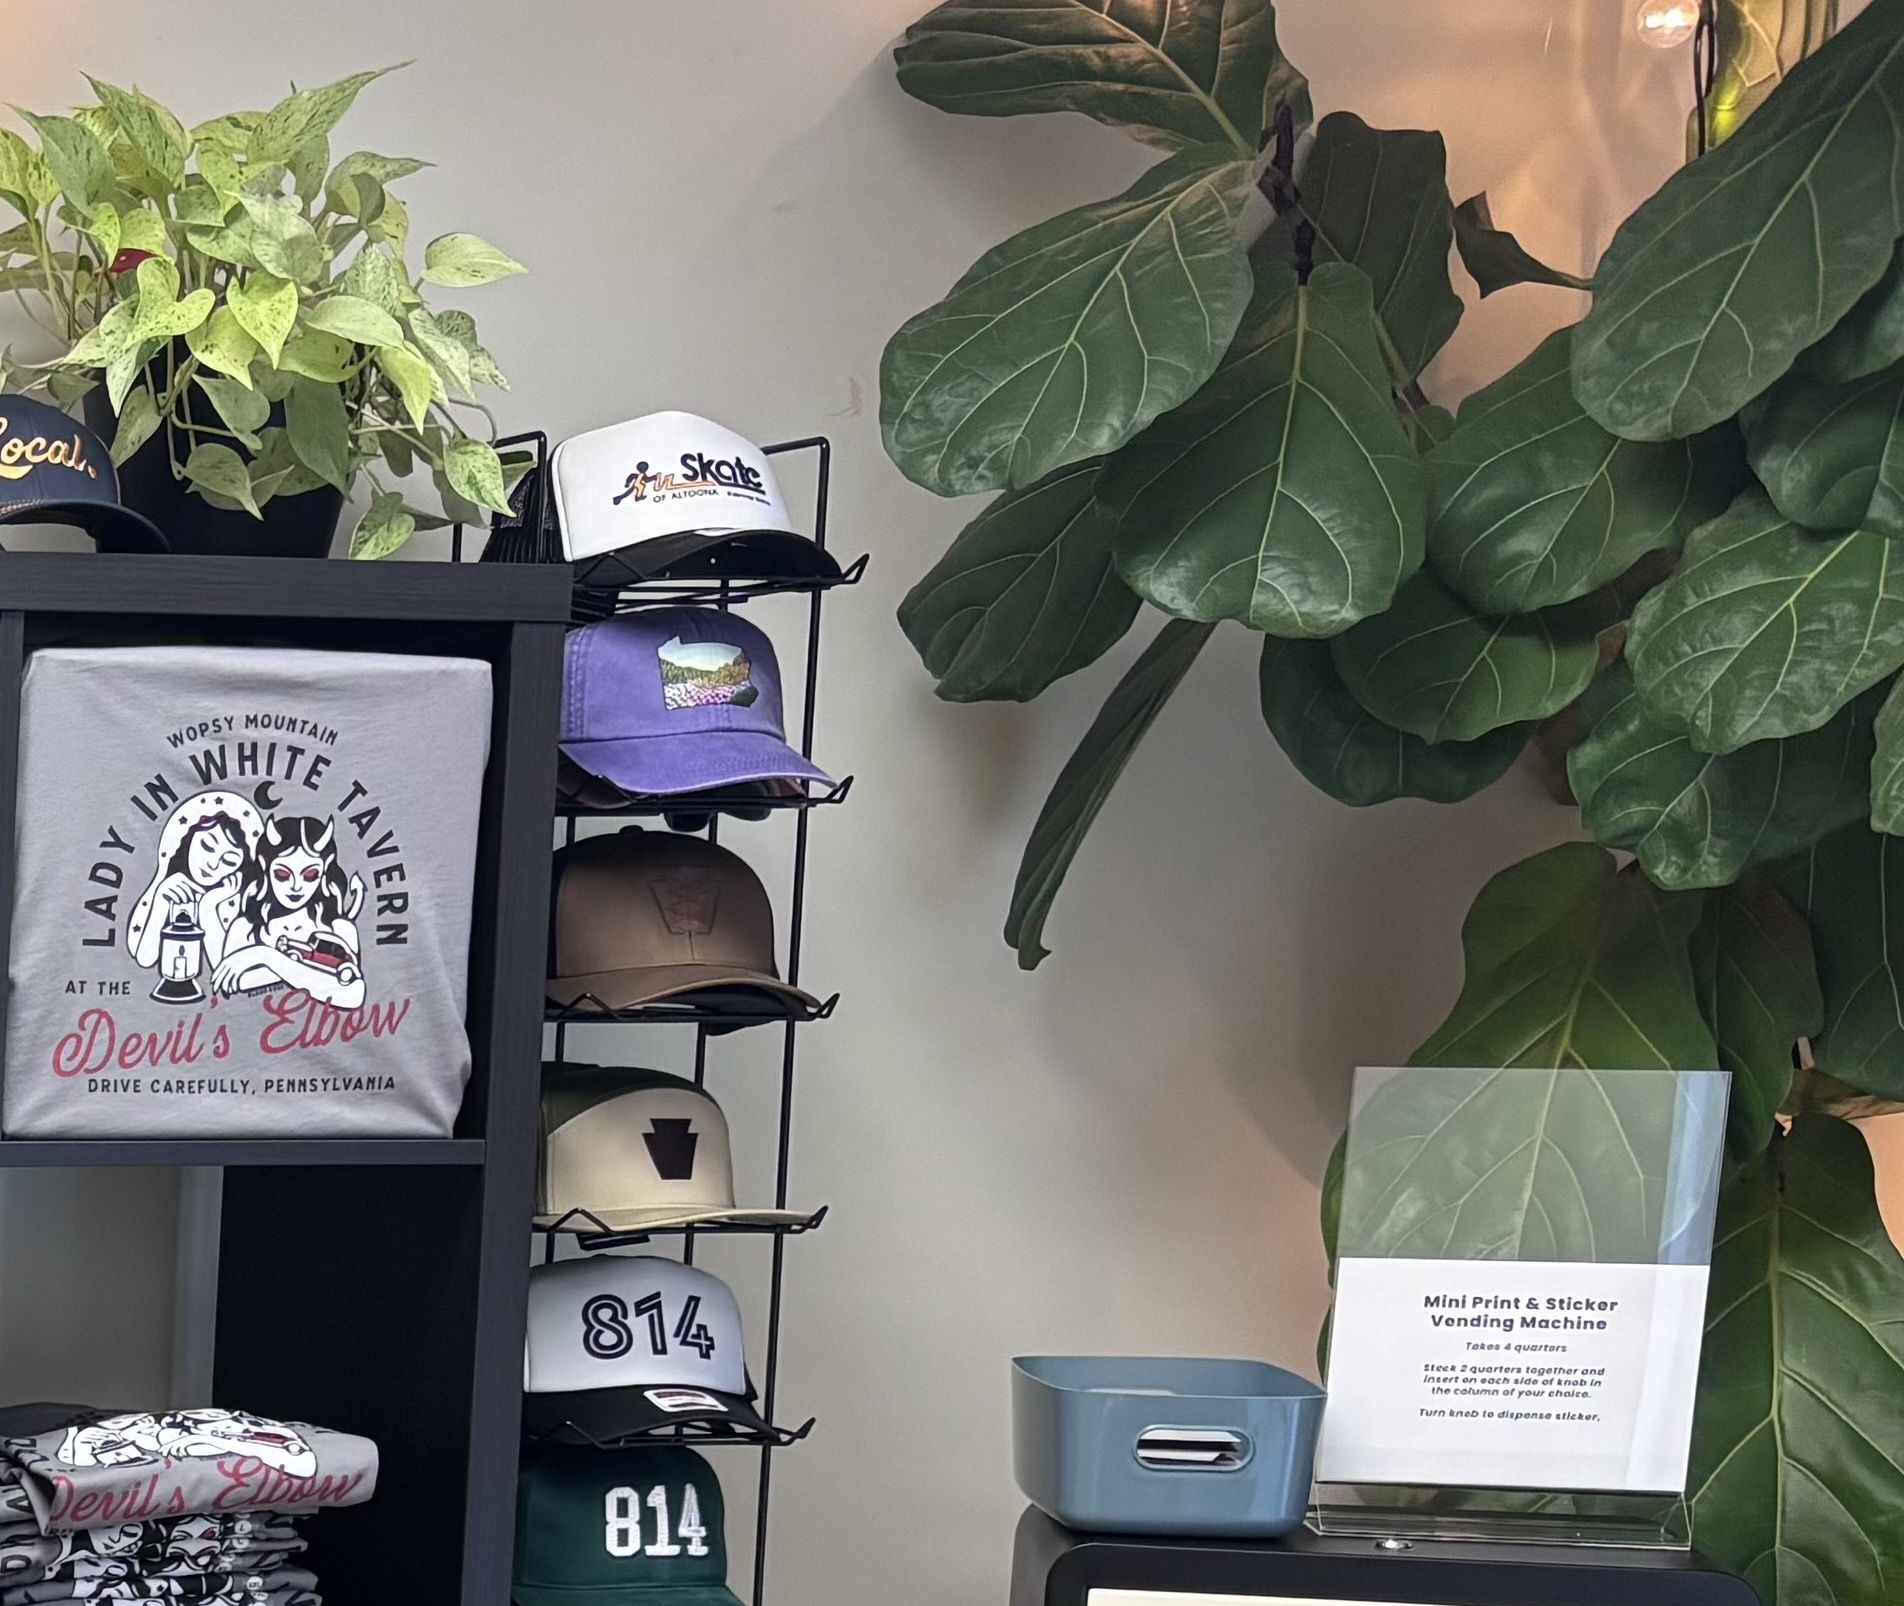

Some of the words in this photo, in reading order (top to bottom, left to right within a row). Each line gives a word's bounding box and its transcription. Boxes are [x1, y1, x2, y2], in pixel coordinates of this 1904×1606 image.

[680, 453, 765, 493] Skate
[653, 494, 667, 503] OF
[672, 489, 720, 500] ALTOONA
[166, 715, 235, 750] WOPSY
[245, 713, 339, 746] MOUNTAIN
[82, 826, 136, 948] LADY
[130, 773, 180, 822] IN
[189, 741, 332, 792] WHITE
[337, 779, 409, 946] TAVERN
[65, 979, 89, 995] AT
[97, 979, 131, 996] THE
[52, 995, 232, 1079] Devil's
[260, 988, 412, 1054] Elbow
[88, 1078, 141, 1094] DRIVE
[150, 1078, 256, 1095] CAREFULLY,
[264, 1075, 396, 1093] PENNSYLVANIA
[1424, 1294, 1467, 1308] Mini
[1472, 1295, 1521, 1310] Print
[1526, 1297, 1540, 1310] &
[1546, 1296, 1619, 1311] Sticker
[581, 1291, 716, 1360] 814
[1431, 1314, 1514, 1332] Vending
[1520, 1316, 1607, 1330] Machine
[1465, 1342, 1500, 1351] Takes
[1503, 1342, 1512, 1351] 4
[1514, 1343, 1567, 1354] quarters
[1423, 1363, 1457, 1373] Stack
[1460, 1364, 1468, 1373] 2
[1469, 1365, 1522, 1375] quarters
[1525, 1366, 1578, 1377] together
[1581, 1367, 1606, 1376] and
[1423, 1375, 1459, 1384] insert
[1480, 1376, 1510, 1385] each
[1513, 1377, 1538, 1386] side
[1542, 1377, 1555, 1386] of
[1557, 1378, 1587, 1387] knob
[1590, 1379, 1602, 1387] in
[1431, 1386, 1451, 1395] the
[1453, 1387, 1499, 1396] column
[1502, 1388, 1515, 1397] of
[1517, 1389, 1545, 1399] your
[1419, 1408, 1445, 1417] Turn
[1449, 1408, 1479, 1418] knob
[1482, 1410, 1494, 1418] to
[1497, 1410, 1552, 1421] dispense
[211, 1456, 364, 1510] Elbow
[605, 1484, 708, 1558] 814
